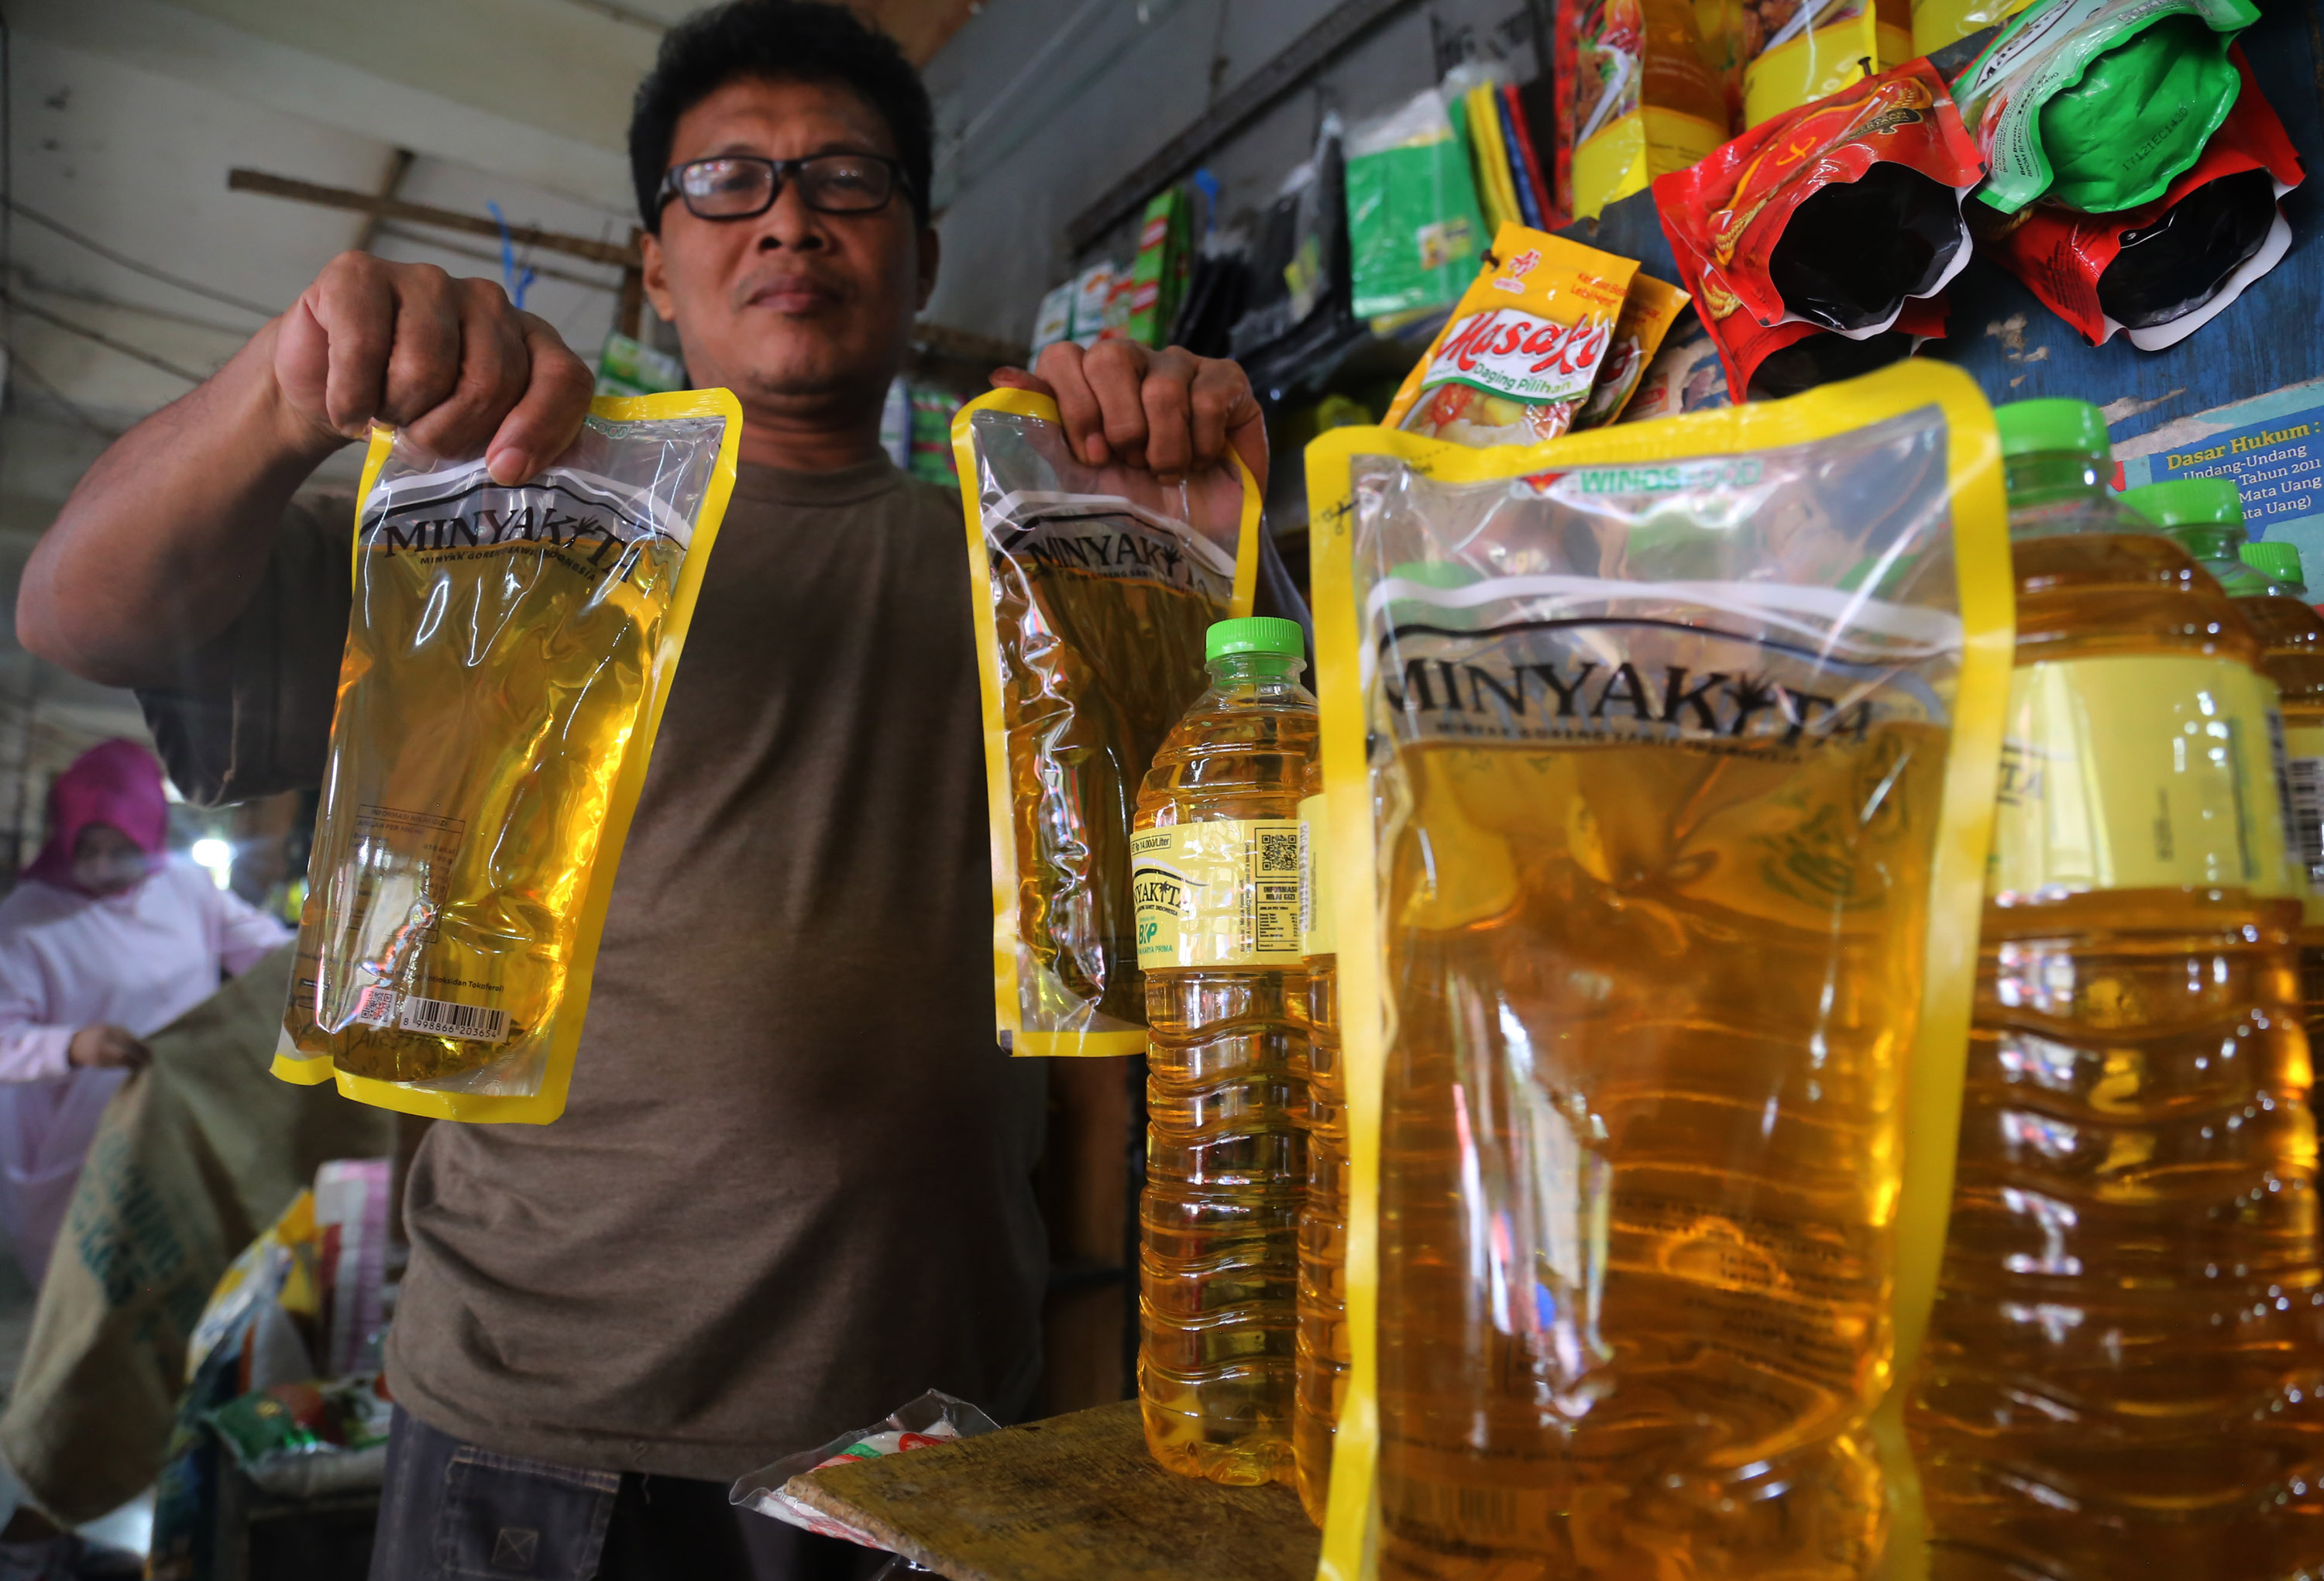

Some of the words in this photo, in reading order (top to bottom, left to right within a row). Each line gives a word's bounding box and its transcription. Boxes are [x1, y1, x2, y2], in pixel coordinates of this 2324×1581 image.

[1435, 311, 1604, 376] Masako
[1473, 363, 1516, 390] Daging
[1517, 379, 1571, 394] Pilihan
[2166, 445, 2225, 470] Dasar
[2229, 424, 2309, 454] Hukum
[2183, 445, 2307, 479] Undang-Undang
[2239, 467, 2288, 486] Tahun
[2291, 459, 2322, 474] 2011
[2238, 486, 2277, 504] Mata
[2281, 476, 2322, 496] Uang
[2266, 495, 2312, 515] Uang)
[420, 552, 466, 565] MINYAK
[1139, 923, 1158, 945] BKP
[468, 980, 504, 992] Tokoferol)
[416, 1019, 455, 1033] 998866
[459, 1026, 497, 1039] 203654
